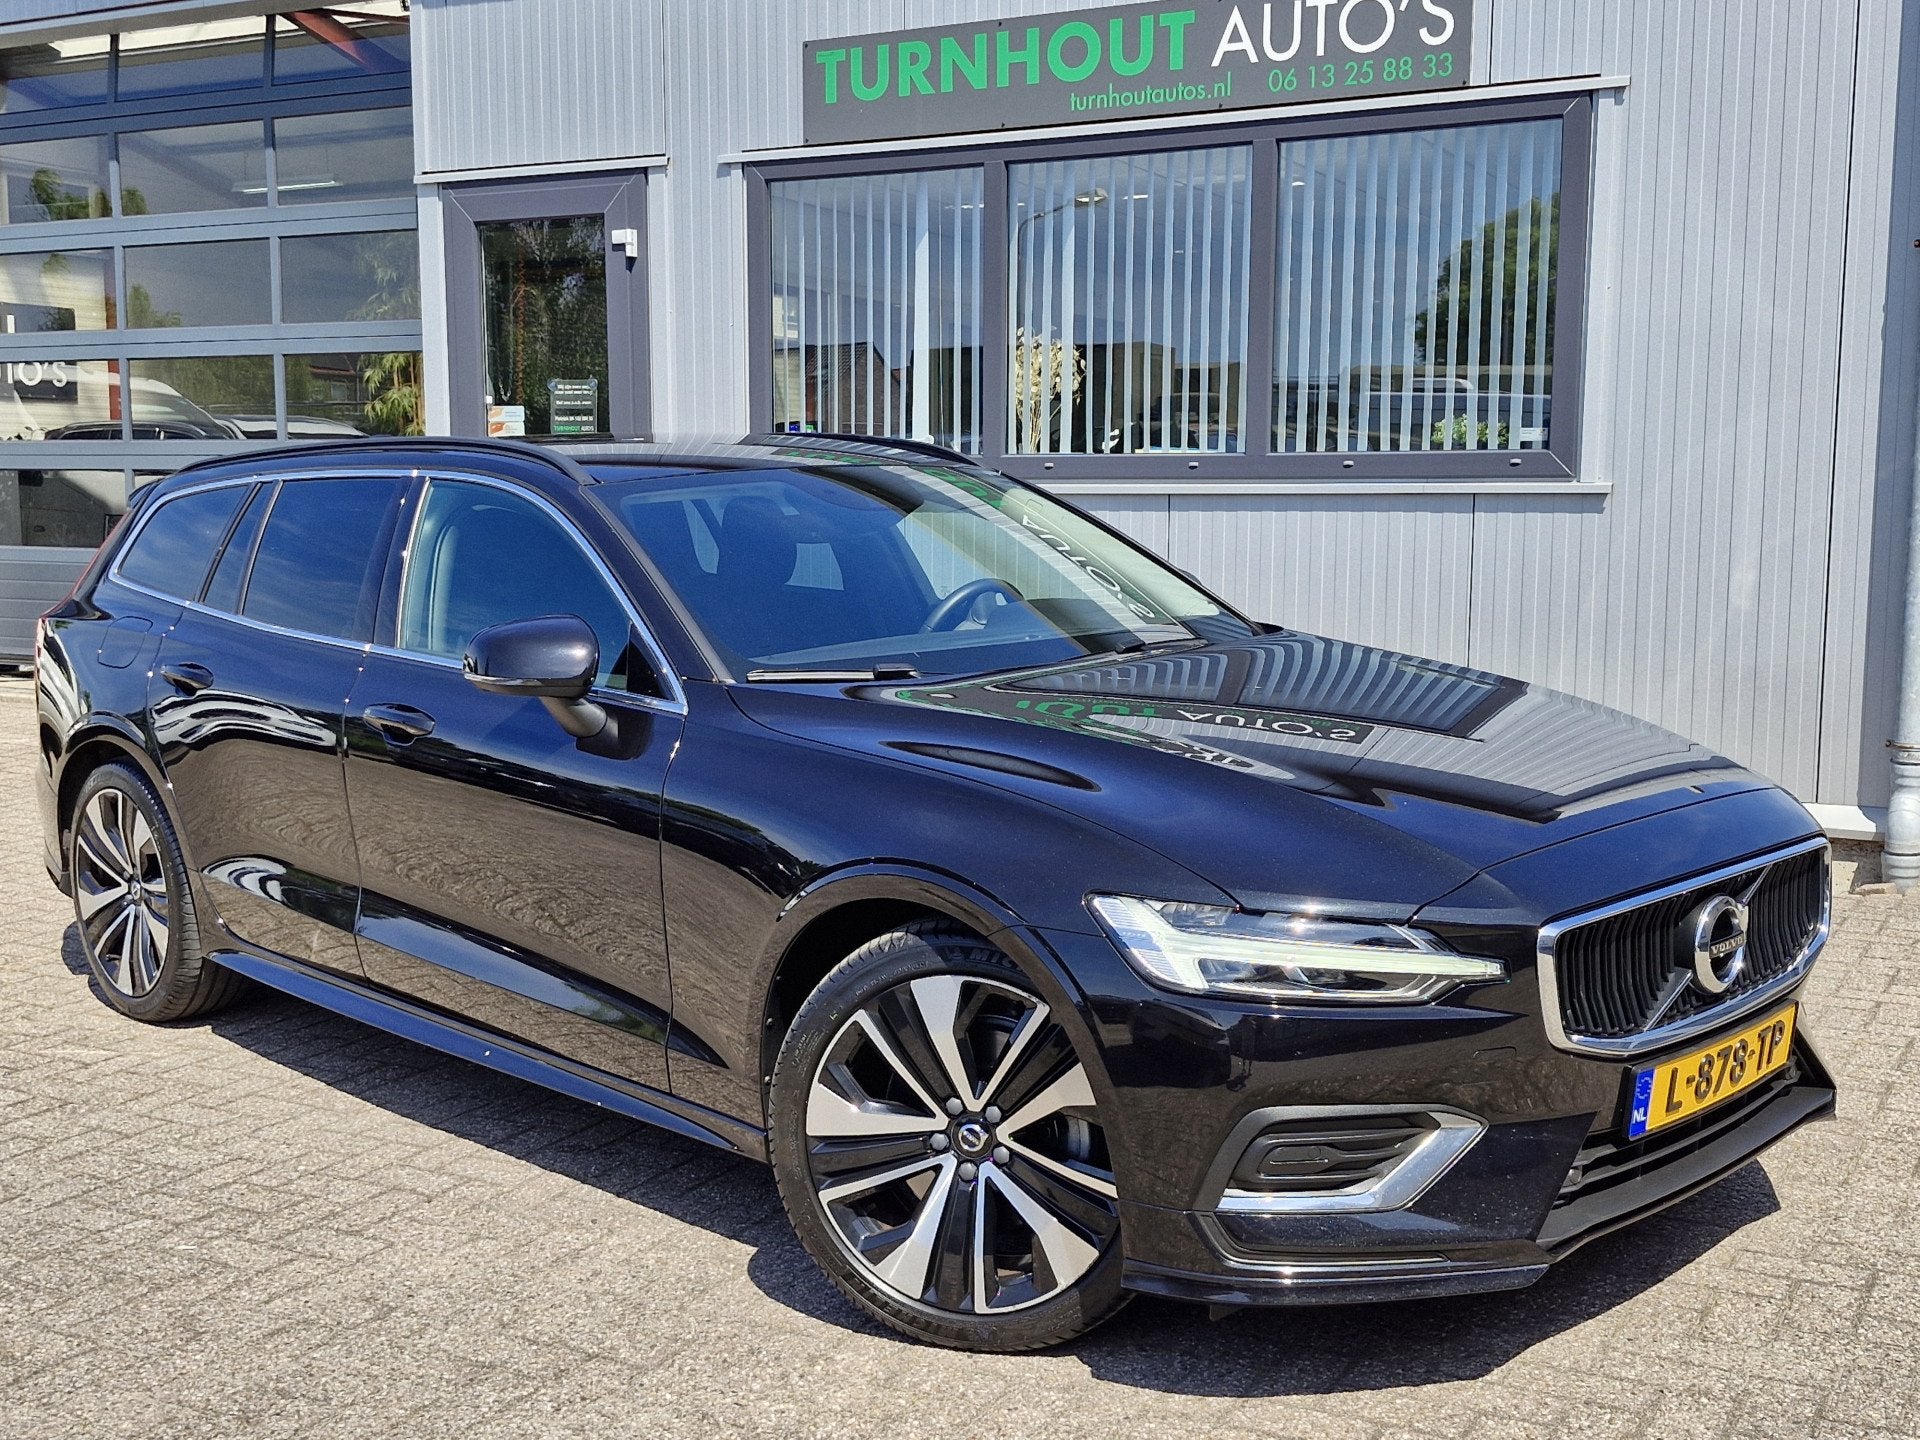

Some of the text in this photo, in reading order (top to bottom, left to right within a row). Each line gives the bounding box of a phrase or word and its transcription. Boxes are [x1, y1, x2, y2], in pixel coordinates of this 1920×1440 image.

[816, 0, 1455, 104] TURNHOUT AUTO'S
[1267, 52, 1454, 93] 06 13 25 88 33
[1070, 71, 1232, 112] turnhoutautos.nl
[1710, 936, 1743, 955] VOLVO
[1665, 1019, 1786, 1115] L-878-TP
[1632, 1107, 1647, 1124] NL
